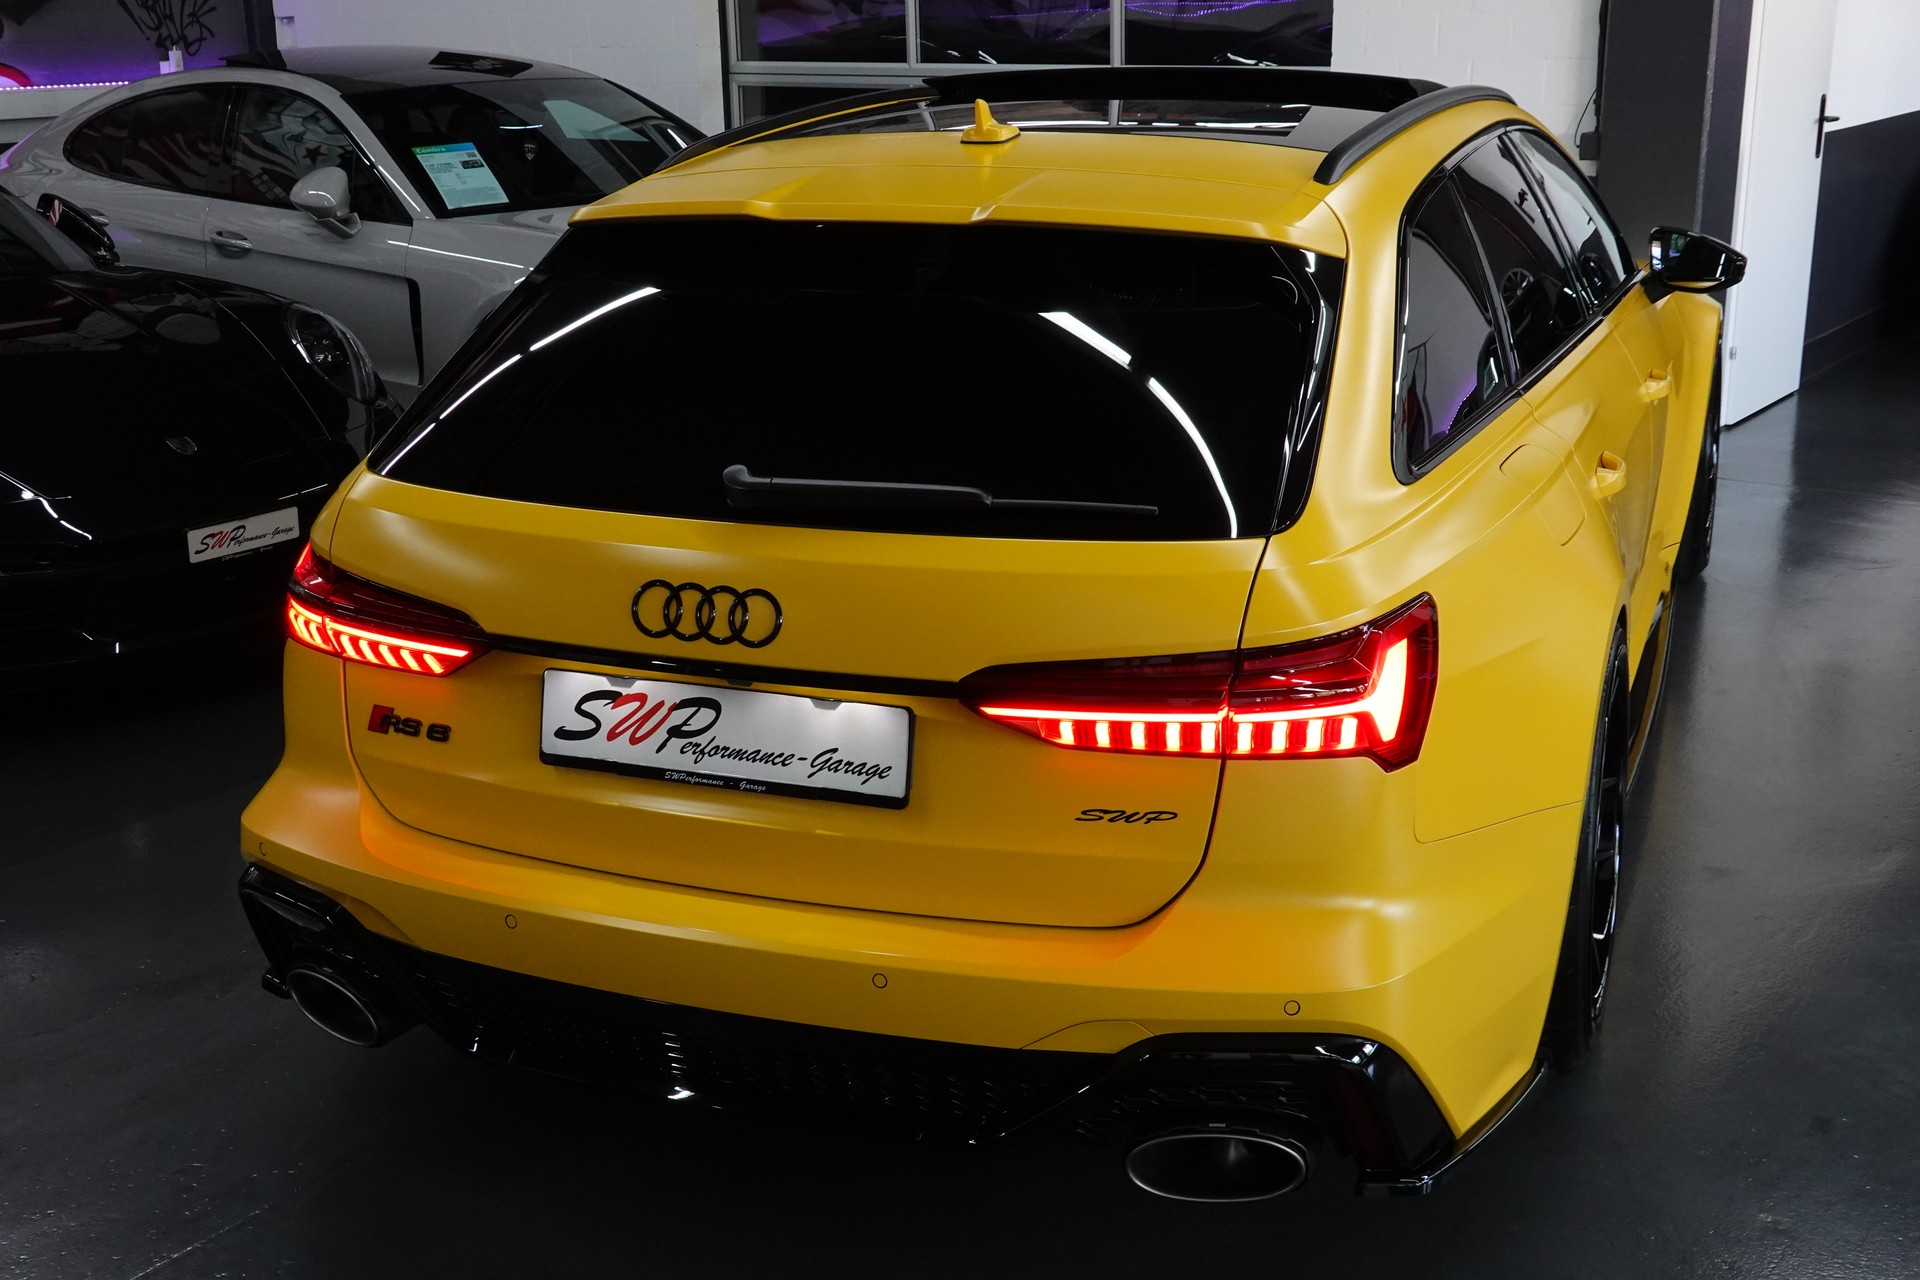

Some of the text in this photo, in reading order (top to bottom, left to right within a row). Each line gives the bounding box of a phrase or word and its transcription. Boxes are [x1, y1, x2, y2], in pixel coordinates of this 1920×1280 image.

[664, 771, 724, 786] SWPerformance
[739, 781, 766, 792] Garage
[1075, 809, 1178, 824] SWP
